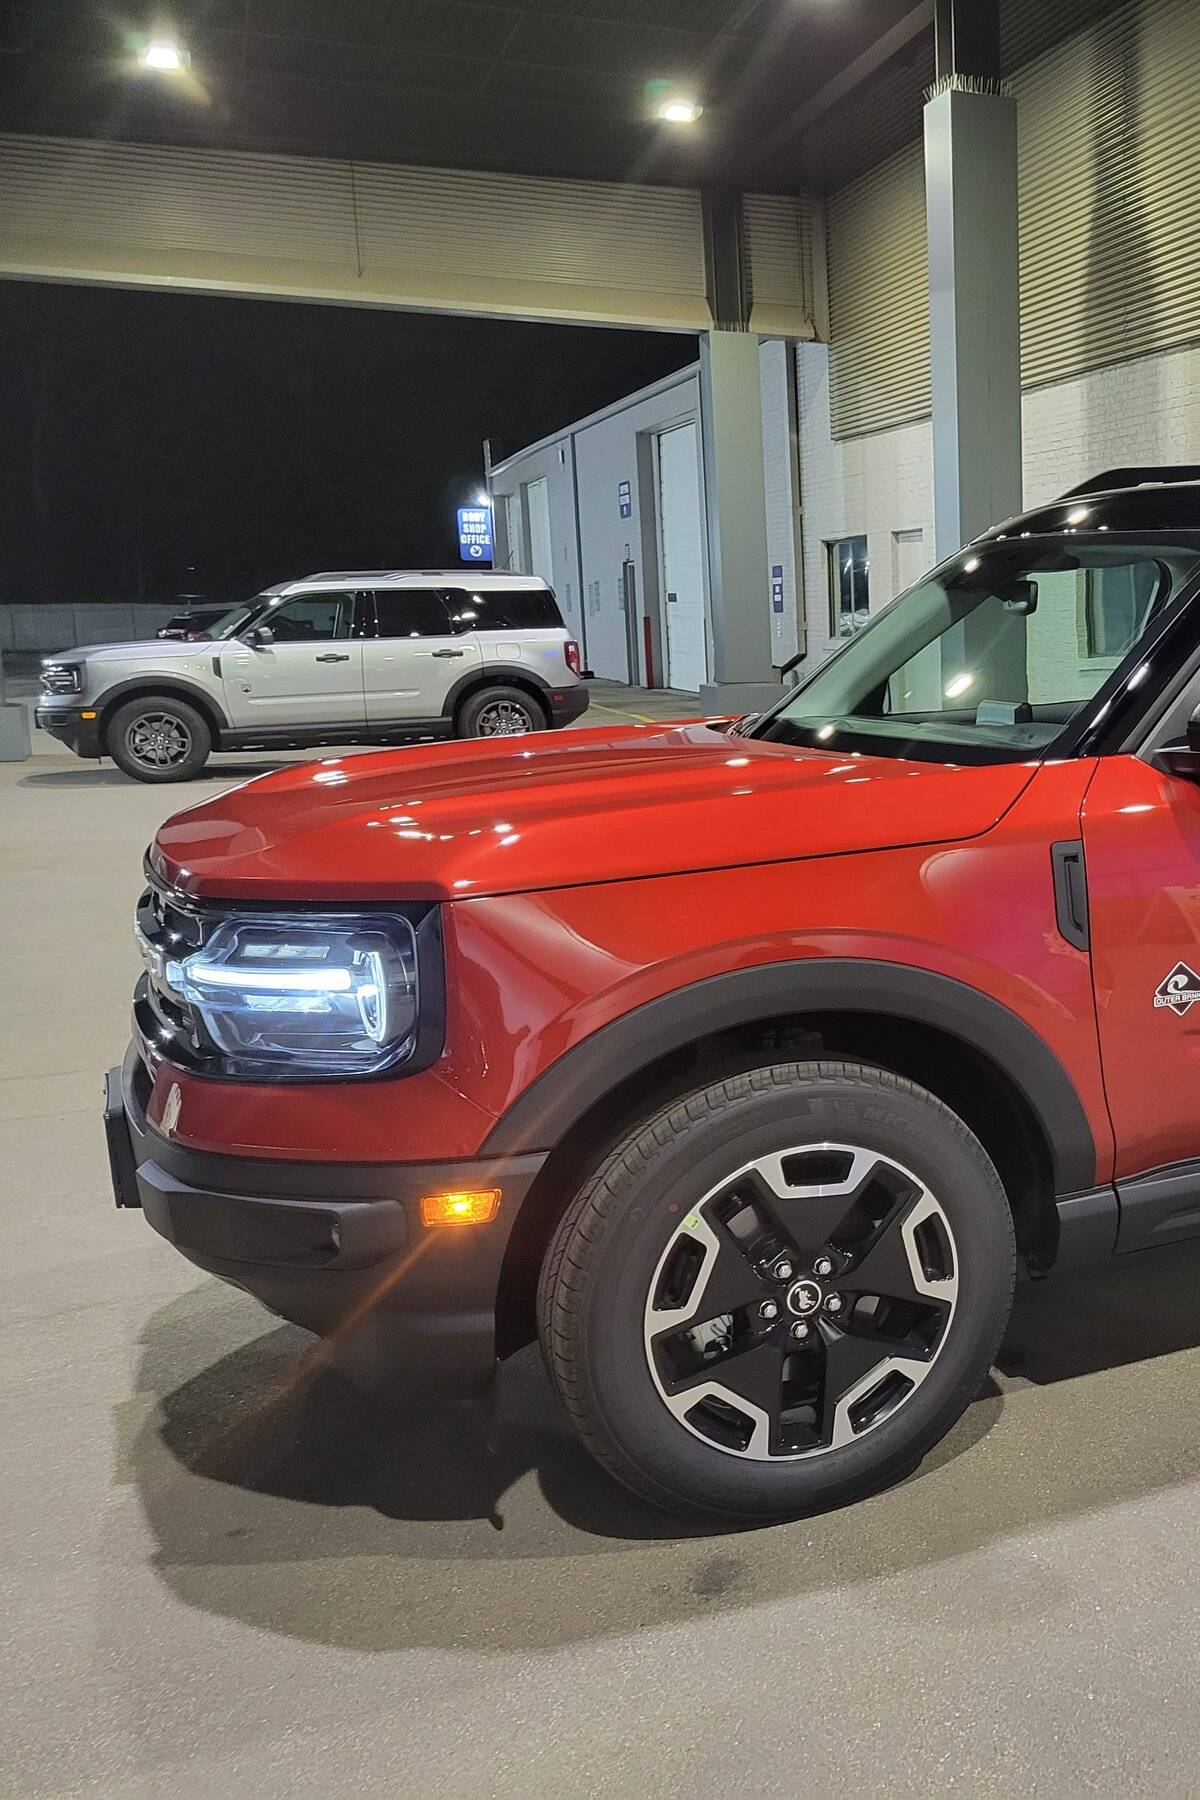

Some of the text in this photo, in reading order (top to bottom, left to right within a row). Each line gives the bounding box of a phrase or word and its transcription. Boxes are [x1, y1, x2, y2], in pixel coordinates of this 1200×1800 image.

[463, 523, 487, 533] SHOP
[460, 534, 491, 544] OFFICE
[1156, 995, 1181, 1005] OUTER
